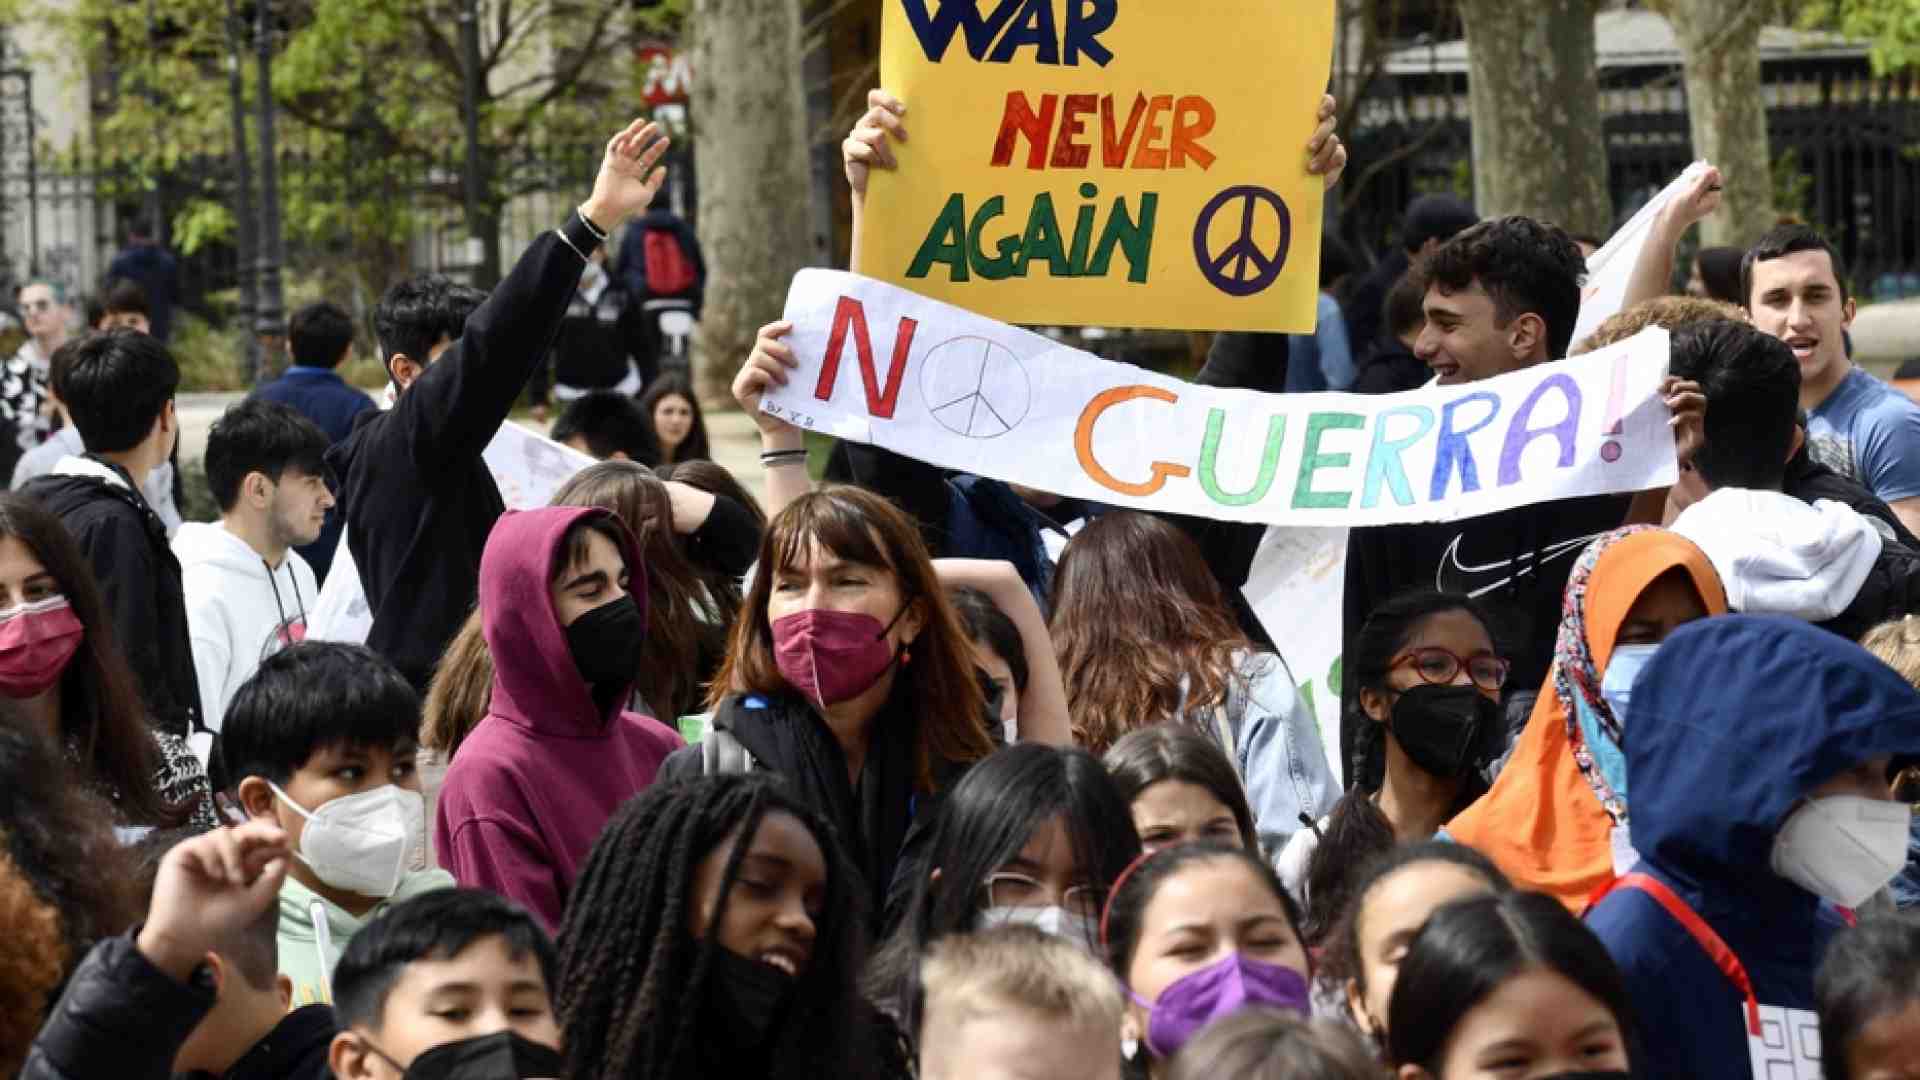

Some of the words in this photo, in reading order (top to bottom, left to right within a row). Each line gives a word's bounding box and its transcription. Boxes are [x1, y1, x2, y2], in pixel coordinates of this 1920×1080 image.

[901, 0, 1118, 68] WAR
[990, 88, 1216, 171] NEVER
[1074, 354, 1628, 509] GUERRA!
